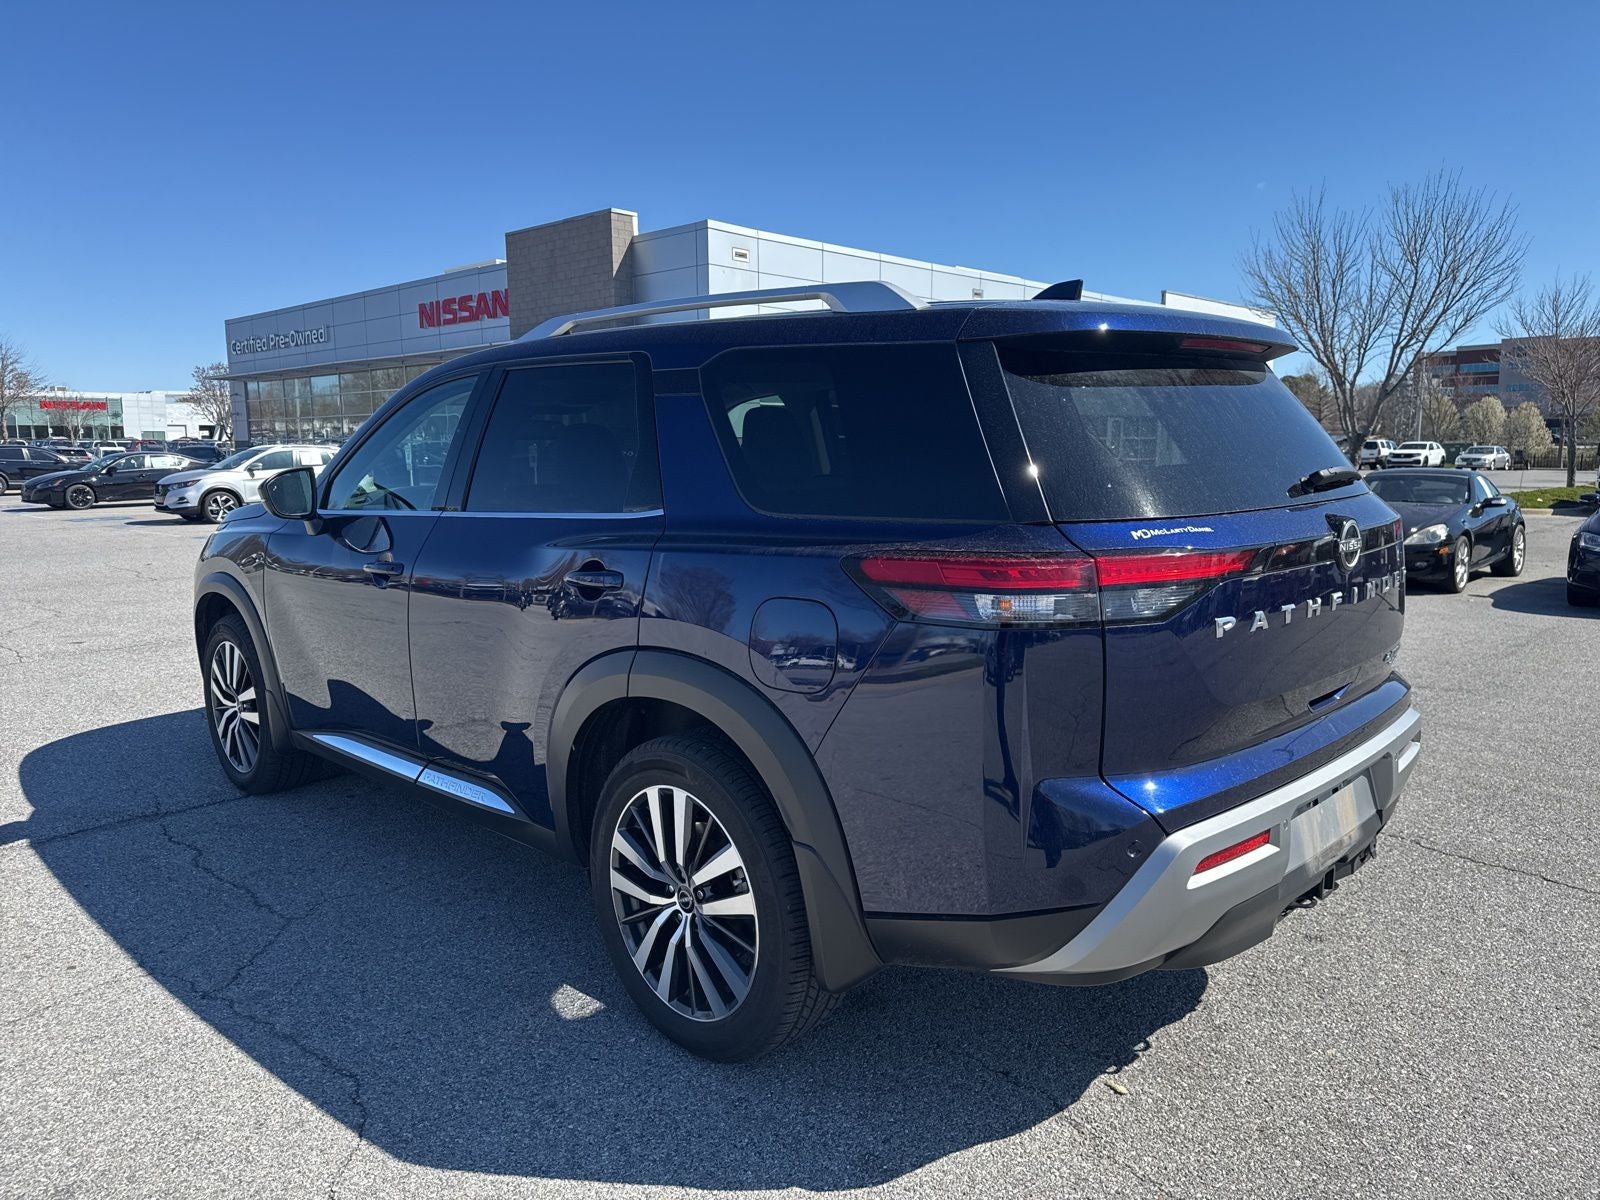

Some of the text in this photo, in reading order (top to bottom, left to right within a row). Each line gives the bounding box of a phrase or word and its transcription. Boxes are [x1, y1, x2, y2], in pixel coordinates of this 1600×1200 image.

[418, 288, 509, 329] NISSAN
[230, 325, 325, 355] Certified Pre-Owned
[1339, 540, 1361, 552] NISS
[1214, 567, 1407, 639] PATHFINDE
[423, 771, 487, 802] PATHFINDER
